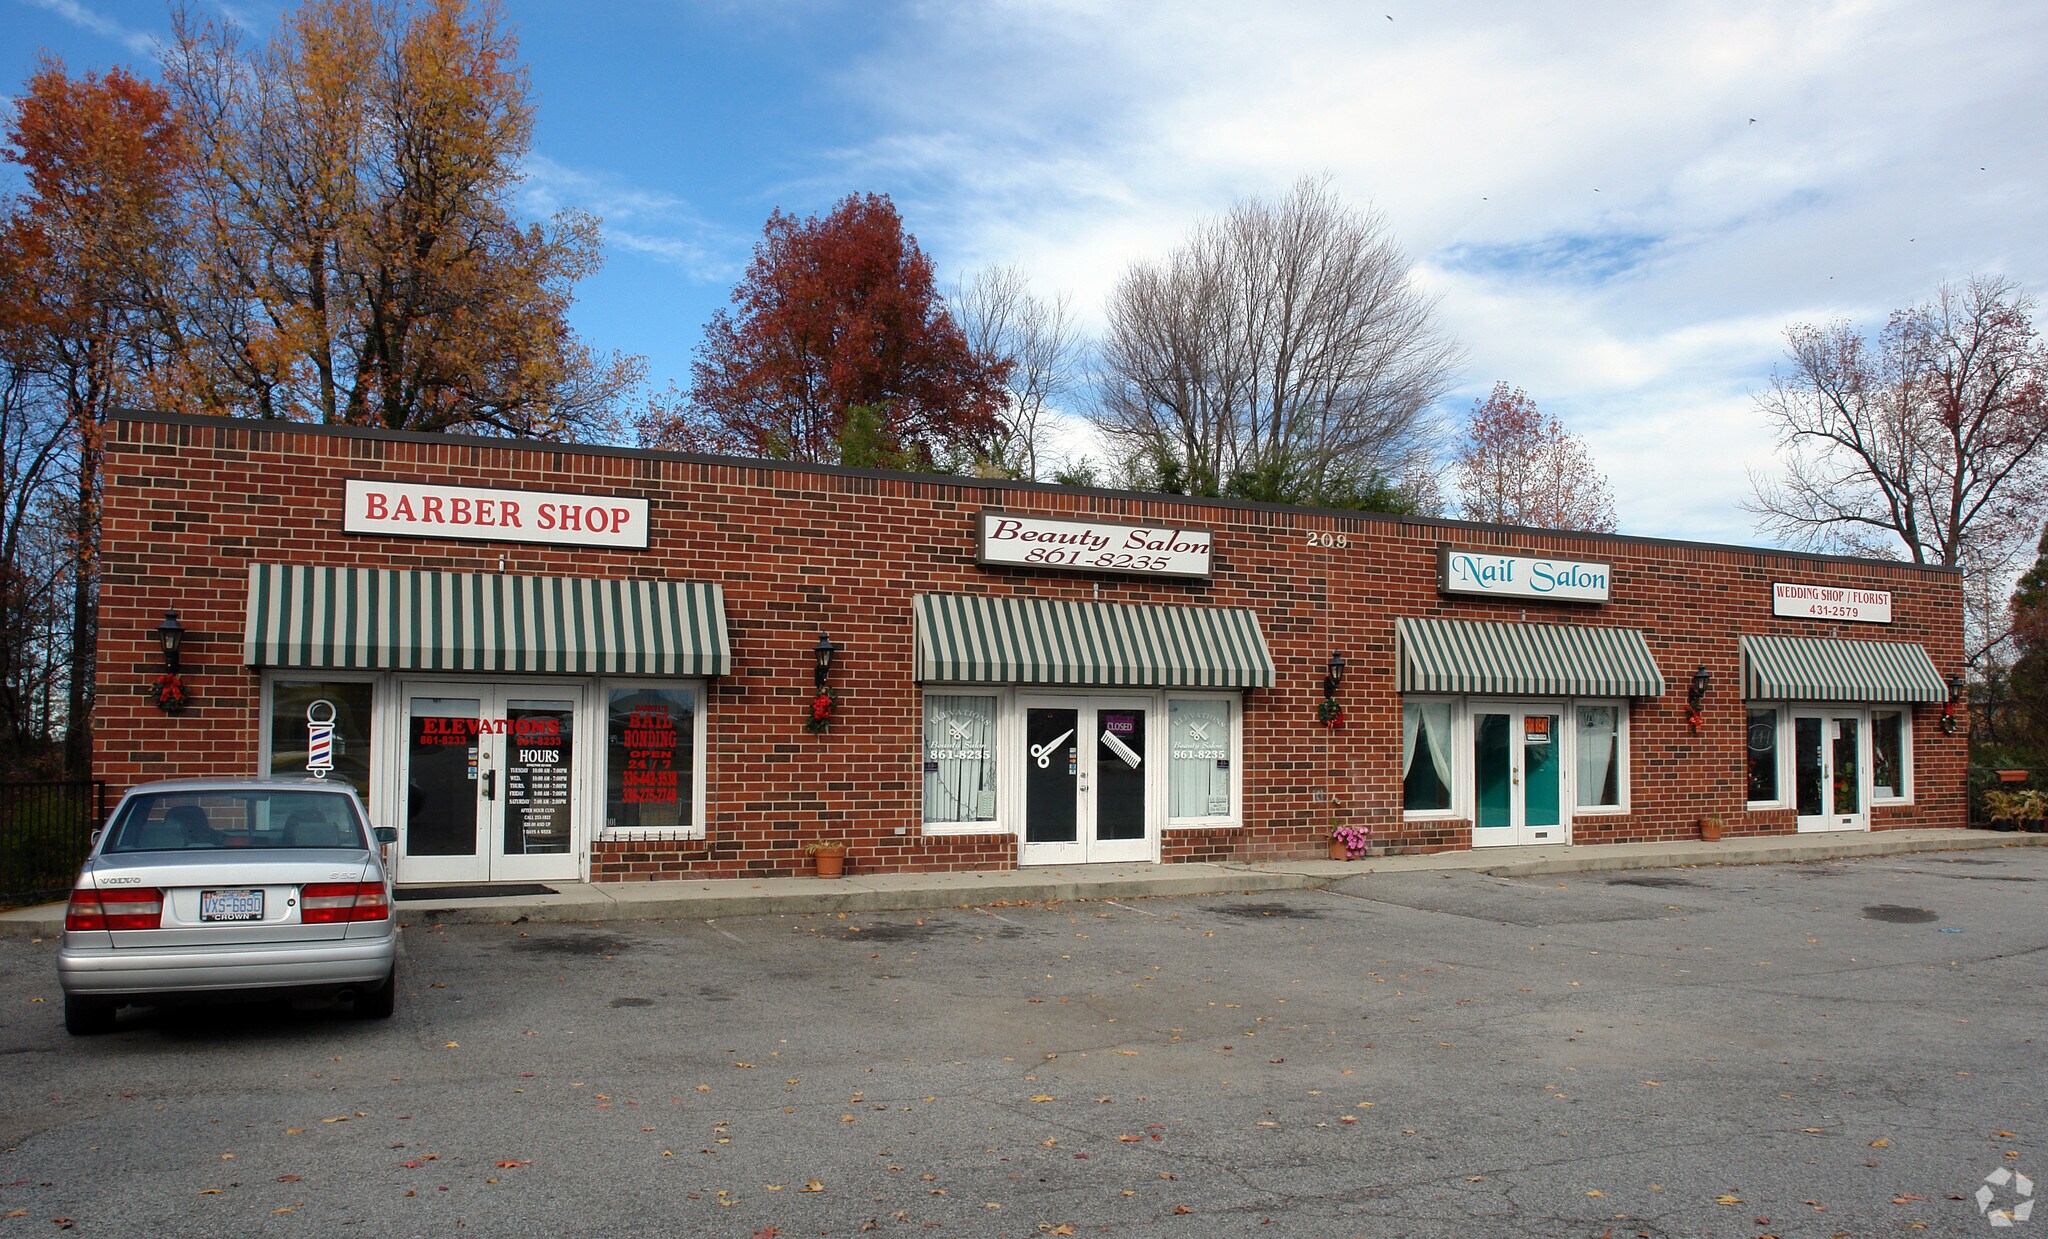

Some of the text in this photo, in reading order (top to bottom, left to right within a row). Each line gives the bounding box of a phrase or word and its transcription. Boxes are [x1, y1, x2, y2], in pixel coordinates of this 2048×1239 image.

[365, 492, 631, 533] BARBER SHOP
[988, 519, 1210, 554] Beauty Salon
[1306, 531, 1348, 549] 209
[1024, 547, 1172, 571] 861-8235
[1452, 555, 1606, 592] Nail Salon
[1776, 585, 1819, 600] WEDDING
[1821, 589, 1844, 602] SHOP
[1853, 592, 1888, 605] FLORIST
[1809, 604, 1859, 617] 431-2579
[629, 713, 673, 728] BAIL
[930, 710, 991, 726] ELEVATIONS
[1173, 712, 1226, 727] ELEVATIONS
[423, 717, 560, 735] ELEVATIONS
[1107, 722, 1133, 731] CLOSED
[420, 736, 467, 745] 861-8233
[623, 730, 677, 747] BONDING
[930, 740, 987, 750] Beauty Salon
[1173, 741, 1222, 750] Beauty Salon
[519, 749, 559, 763] HOURS
[629, 750, 672, 758] OPEN
[930, 749, 991, 760] 861-8235
[1173, 750, 1225, 759] 861-8235
[628, 759, 647, 769] 24
[662, 759, 672, 769] 7
[100, 877, 142, 885] VOLVO
